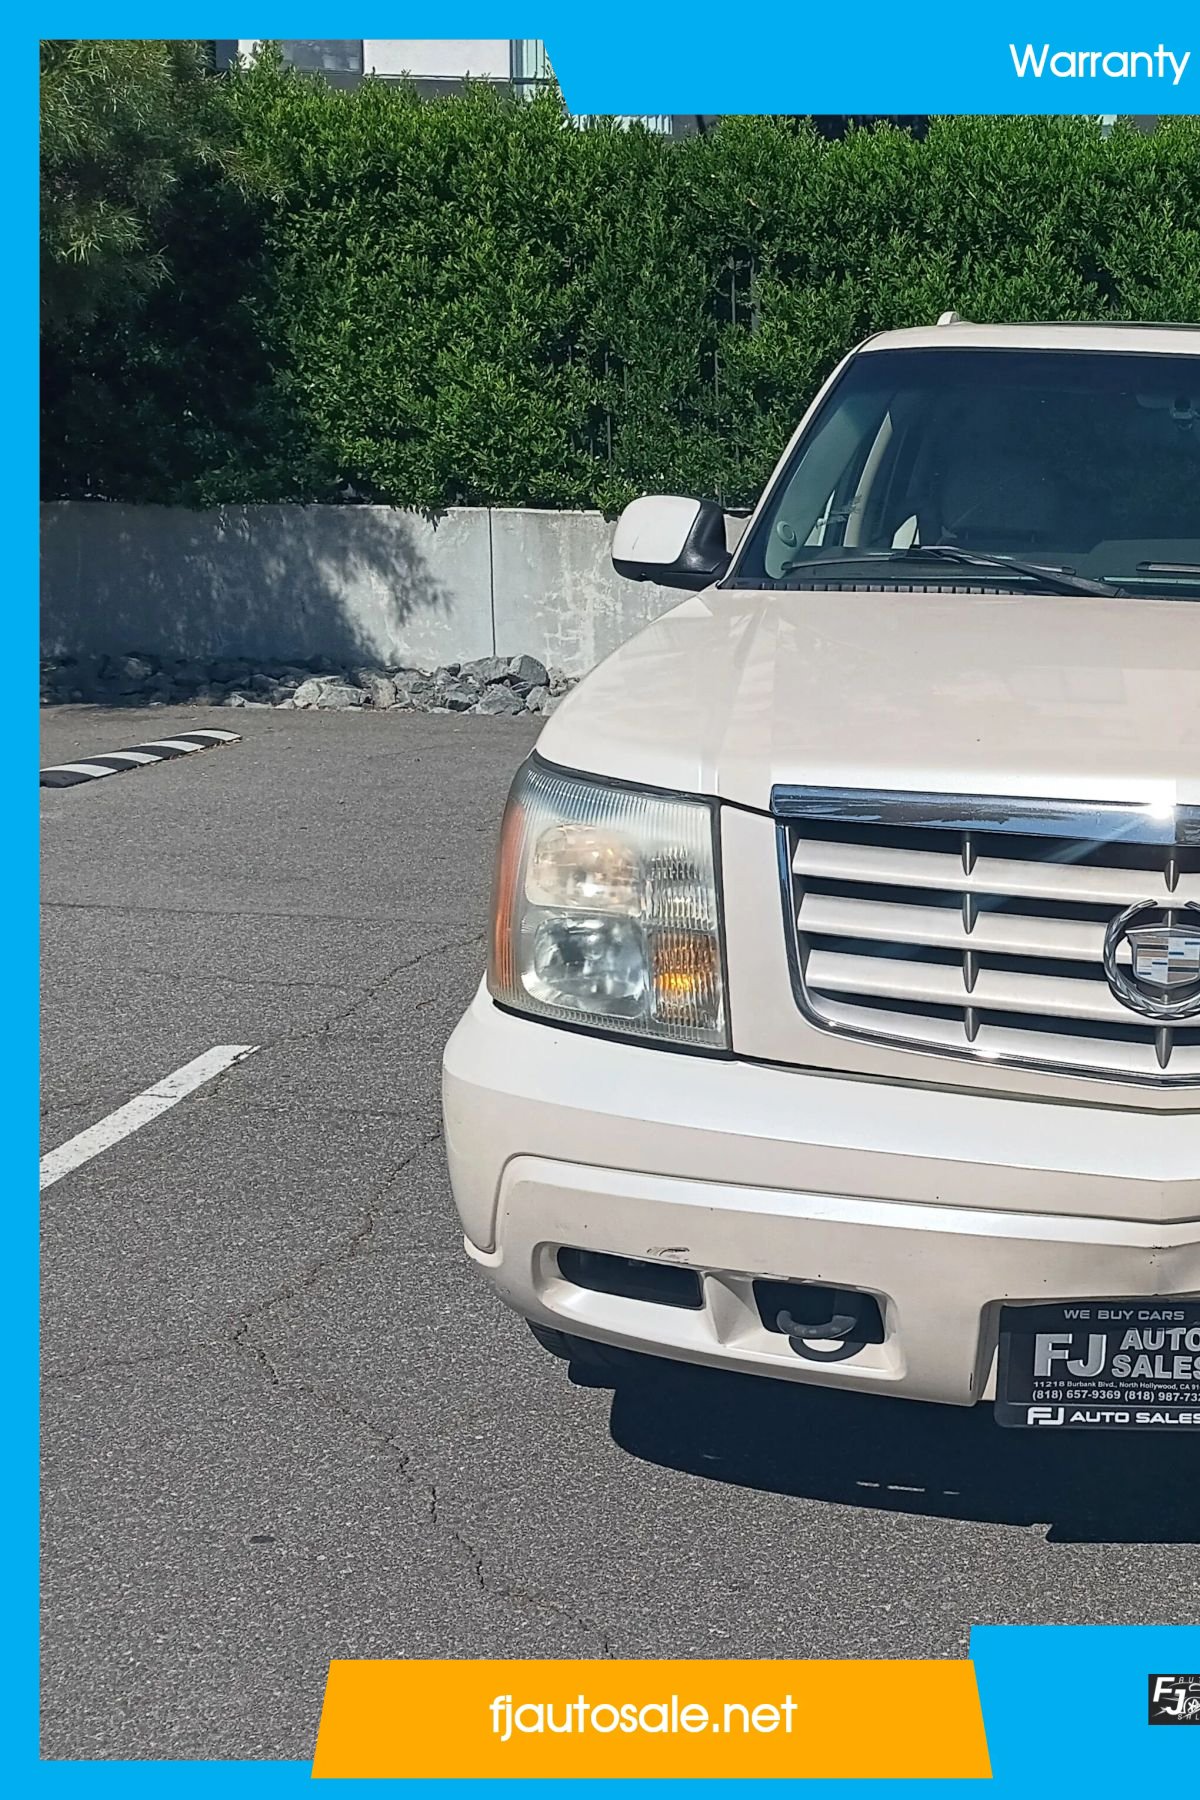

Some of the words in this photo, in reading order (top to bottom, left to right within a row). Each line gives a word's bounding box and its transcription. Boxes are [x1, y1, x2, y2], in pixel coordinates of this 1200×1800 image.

[1064, 1309, 1090, 1320] WE
[1098, 1310, 1134, 1321] BUY
[1138, 1310, 1185, 1321] CARS
[1033, 1333, 1107, 1377] FJ
[1140, 1382, 1178, 1390] Hollywood,
[1032, 1389, 1063, 1401] (818)
[1066, 1389, 1121, 1400] 657-9369
[1124, 1390, 1155, 1403] (818)
[1027, 1407, 1065, 1425] FJ
[1070, 1411, 1130, 1424] AUTO
